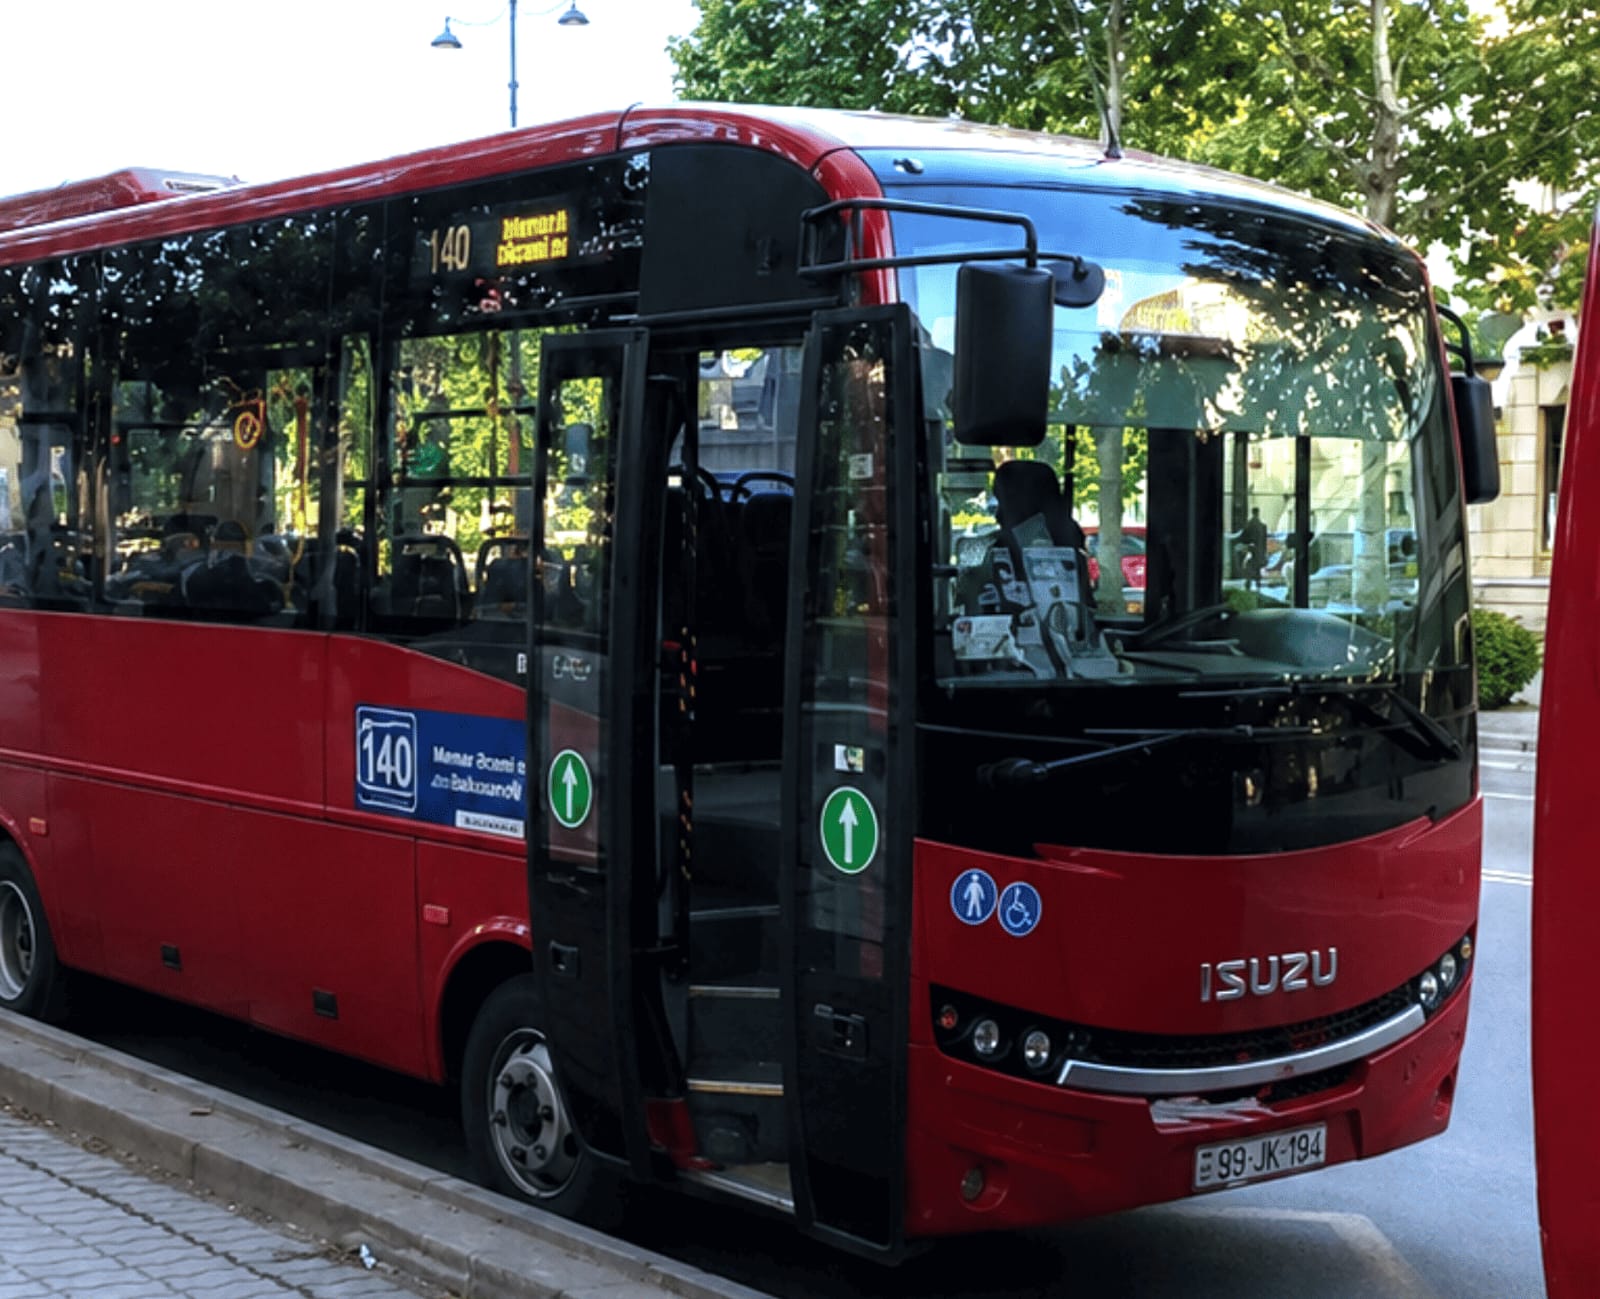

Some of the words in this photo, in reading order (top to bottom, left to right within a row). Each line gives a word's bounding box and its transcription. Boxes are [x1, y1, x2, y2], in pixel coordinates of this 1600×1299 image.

[429, 225, 470, 274] 140
[361, 729, 413, 789] 140
[1200, 947, 1338, 1002] ISUZU
